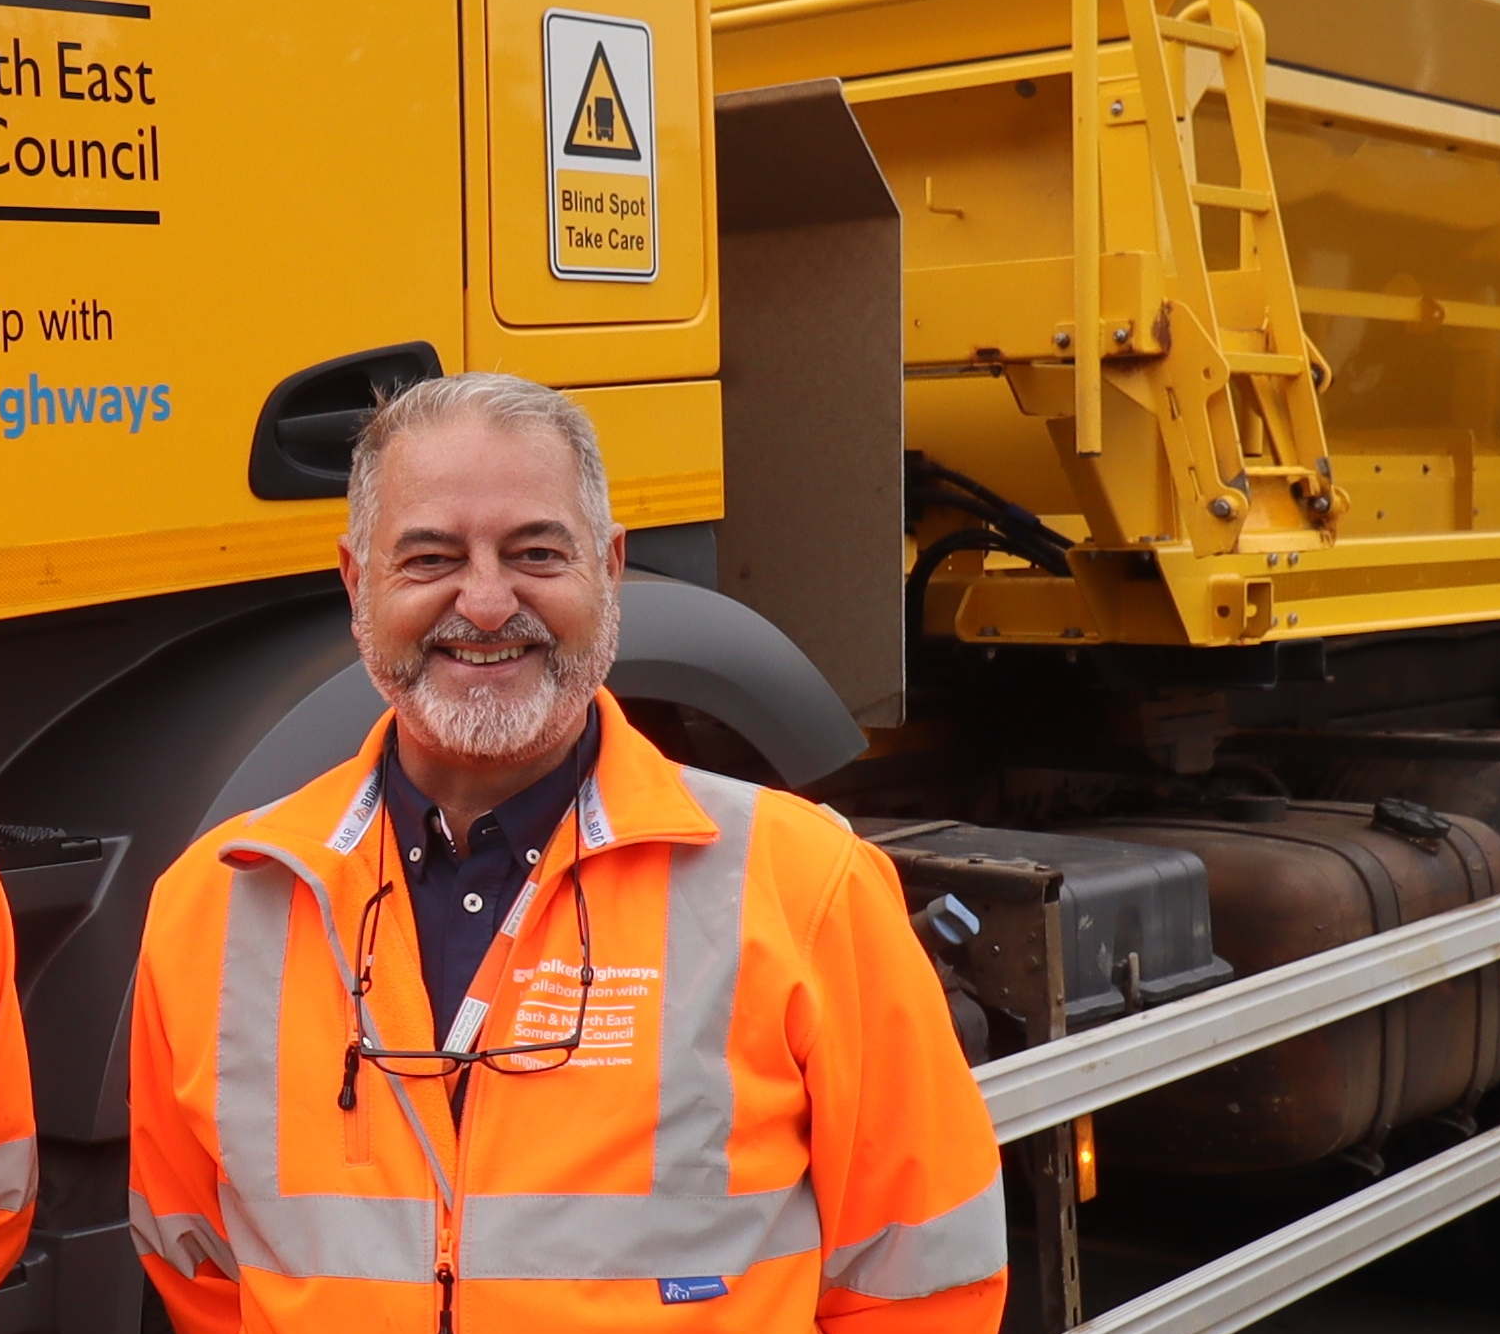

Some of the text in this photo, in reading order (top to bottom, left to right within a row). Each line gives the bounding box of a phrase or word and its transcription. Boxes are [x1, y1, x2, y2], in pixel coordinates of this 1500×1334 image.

[57, 41, 157, 106] East
[561, 190, 646, 221] Blind Spot
[565, 225, 645, 251] Take Care
[38, 298, 114, 342] with
[616, 985, 648, 997] with
[516, 1009, 546, 1024] Bath
[549, 1013, 559, 1026] &
[606, 1014, 634, 1025] East
[581, 1027, 635, 1041] Council
[607, 1056, 632, 1066] Lives
